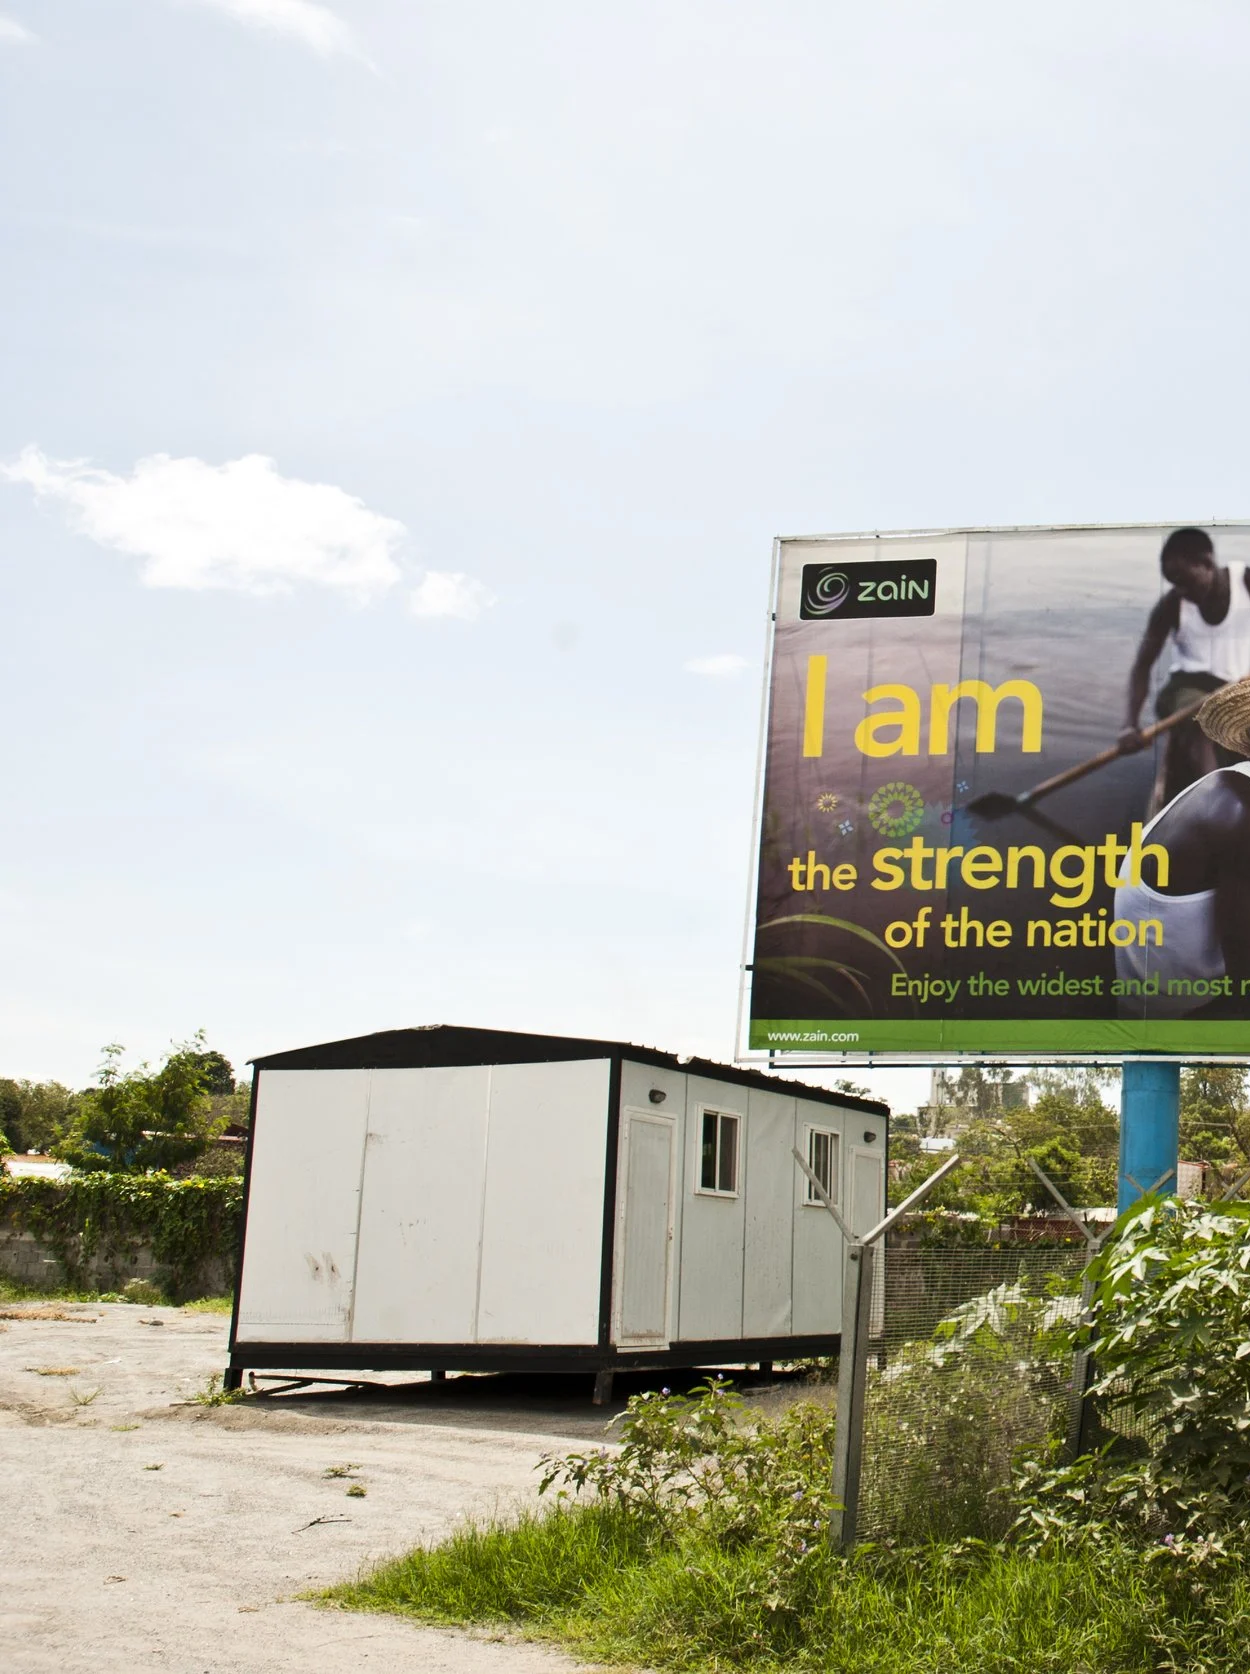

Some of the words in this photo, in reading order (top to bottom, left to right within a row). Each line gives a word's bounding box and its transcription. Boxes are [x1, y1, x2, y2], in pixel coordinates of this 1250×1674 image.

[802, 654, 828, 758] I
[853, 679, 1044, 759] am
[787, 850, 858, 891] the
[871, 822, 1169, 909] strength
[884, 906, 934, 949] of
[940, 906, 1013, 948] the
[1027, 911, 1164, 947] nation
[891, 973, 961, 1003] Enjoy
[967, 971, 1010, 996] the
[1017, 971, 1104, 996] widest
[1110, 971, 1161, 996] and
[1167, 975, 1233, 996] most
[767, 1030, 859, 1042] www.zain.com
